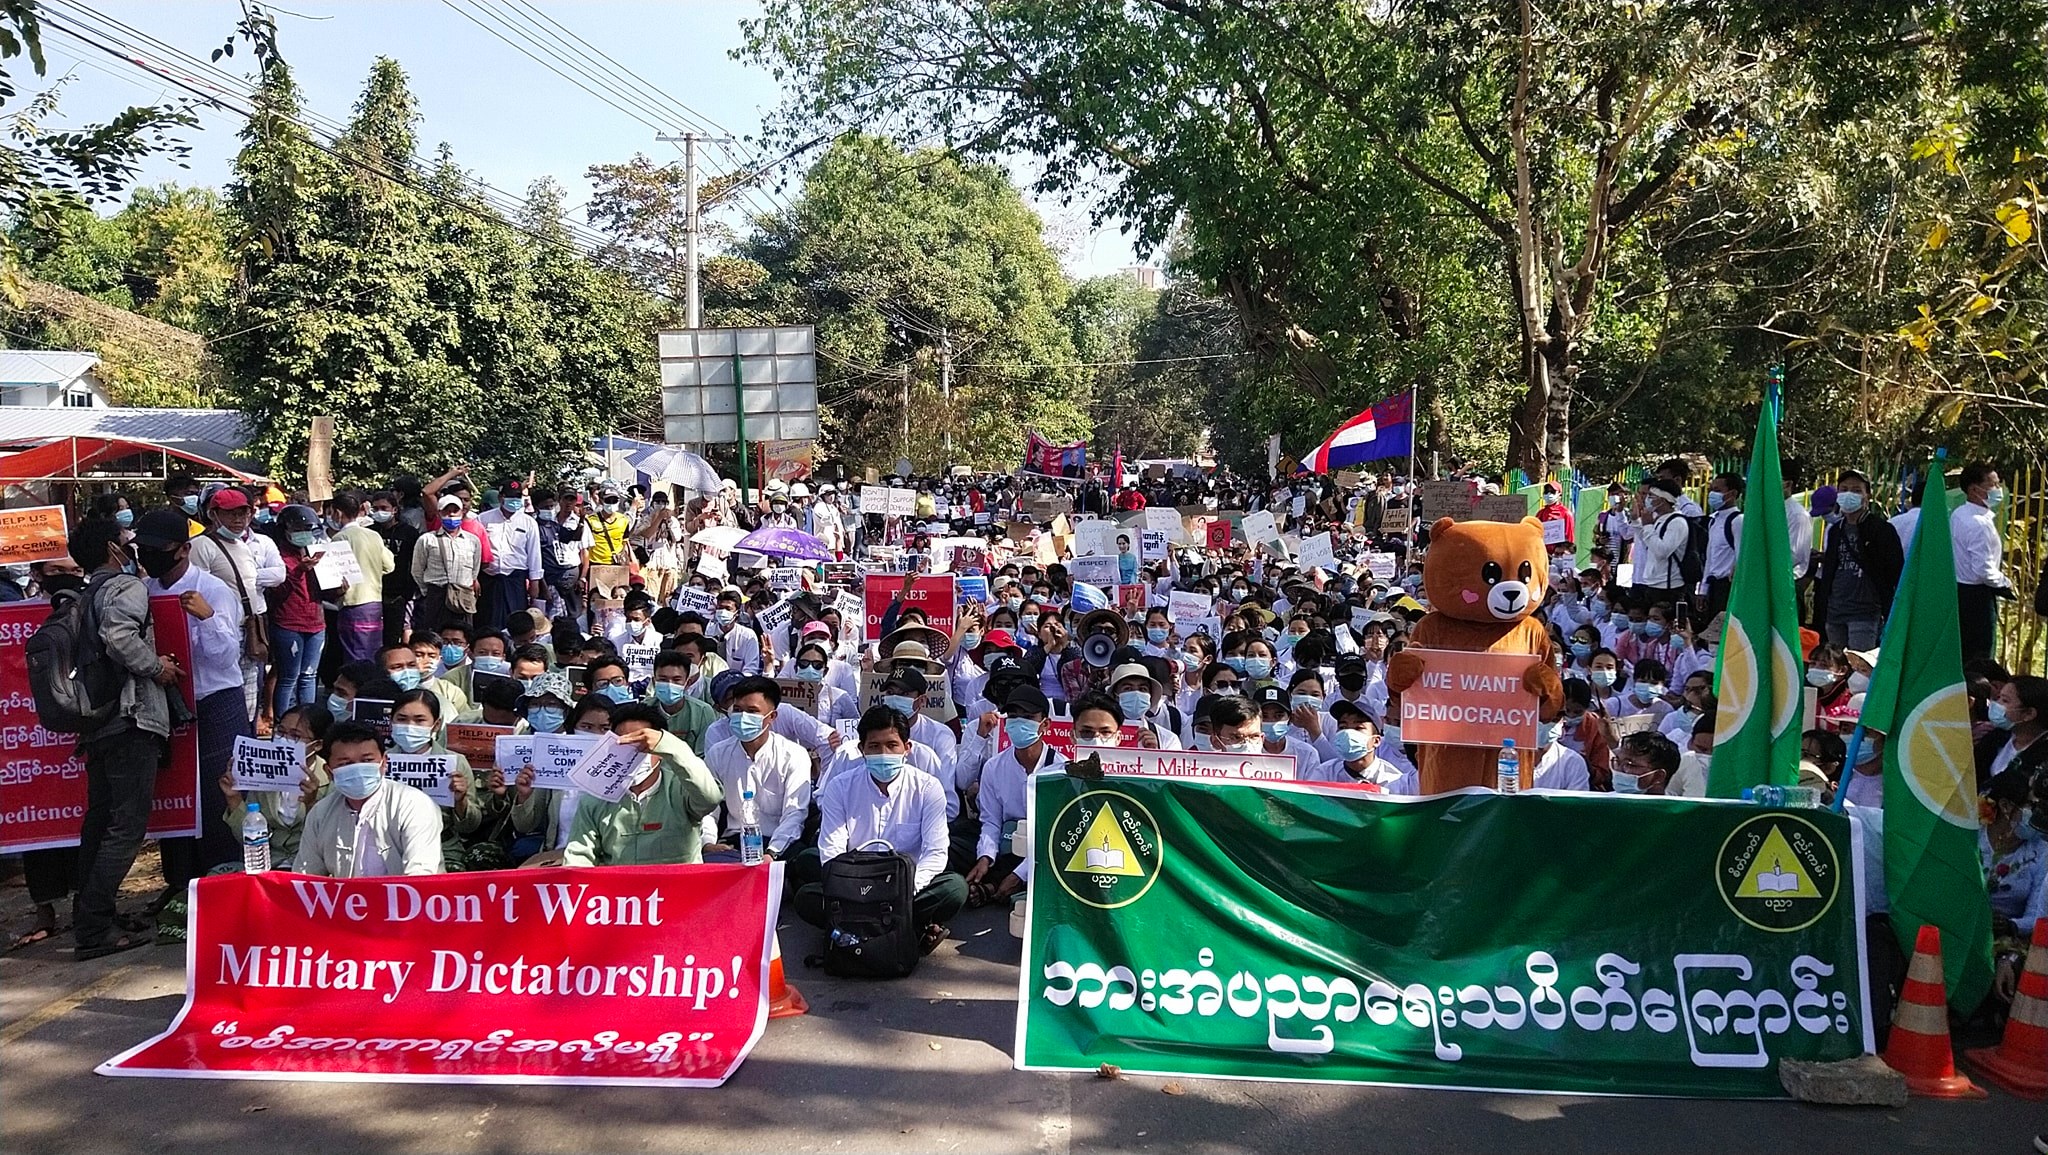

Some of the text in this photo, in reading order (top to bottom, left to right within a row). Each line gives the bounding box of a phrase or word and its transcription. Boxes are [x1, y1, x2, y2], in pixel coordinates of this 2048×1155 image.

[0, 514, 48, 526] ELP US
[21, 540, 60, 551] CRIME
[1422, 671, 1520, 693] WE WANT
[780, 682, 816, 708] တက်နဲ့
[1403, 702, 1536, 727] DEMOCRACY
[458, 729, 484, 738] HELP
[554, 758, 576, 767] CDM
[603, 761, 624, 778] CDM
[1157, 757, 1228, 778] Military
[1239, 760, 1284, 781] Coup
[291, 879, 665, 926] We Don't Want
[215, 943, 743, 1011] Military Dictatorship!
